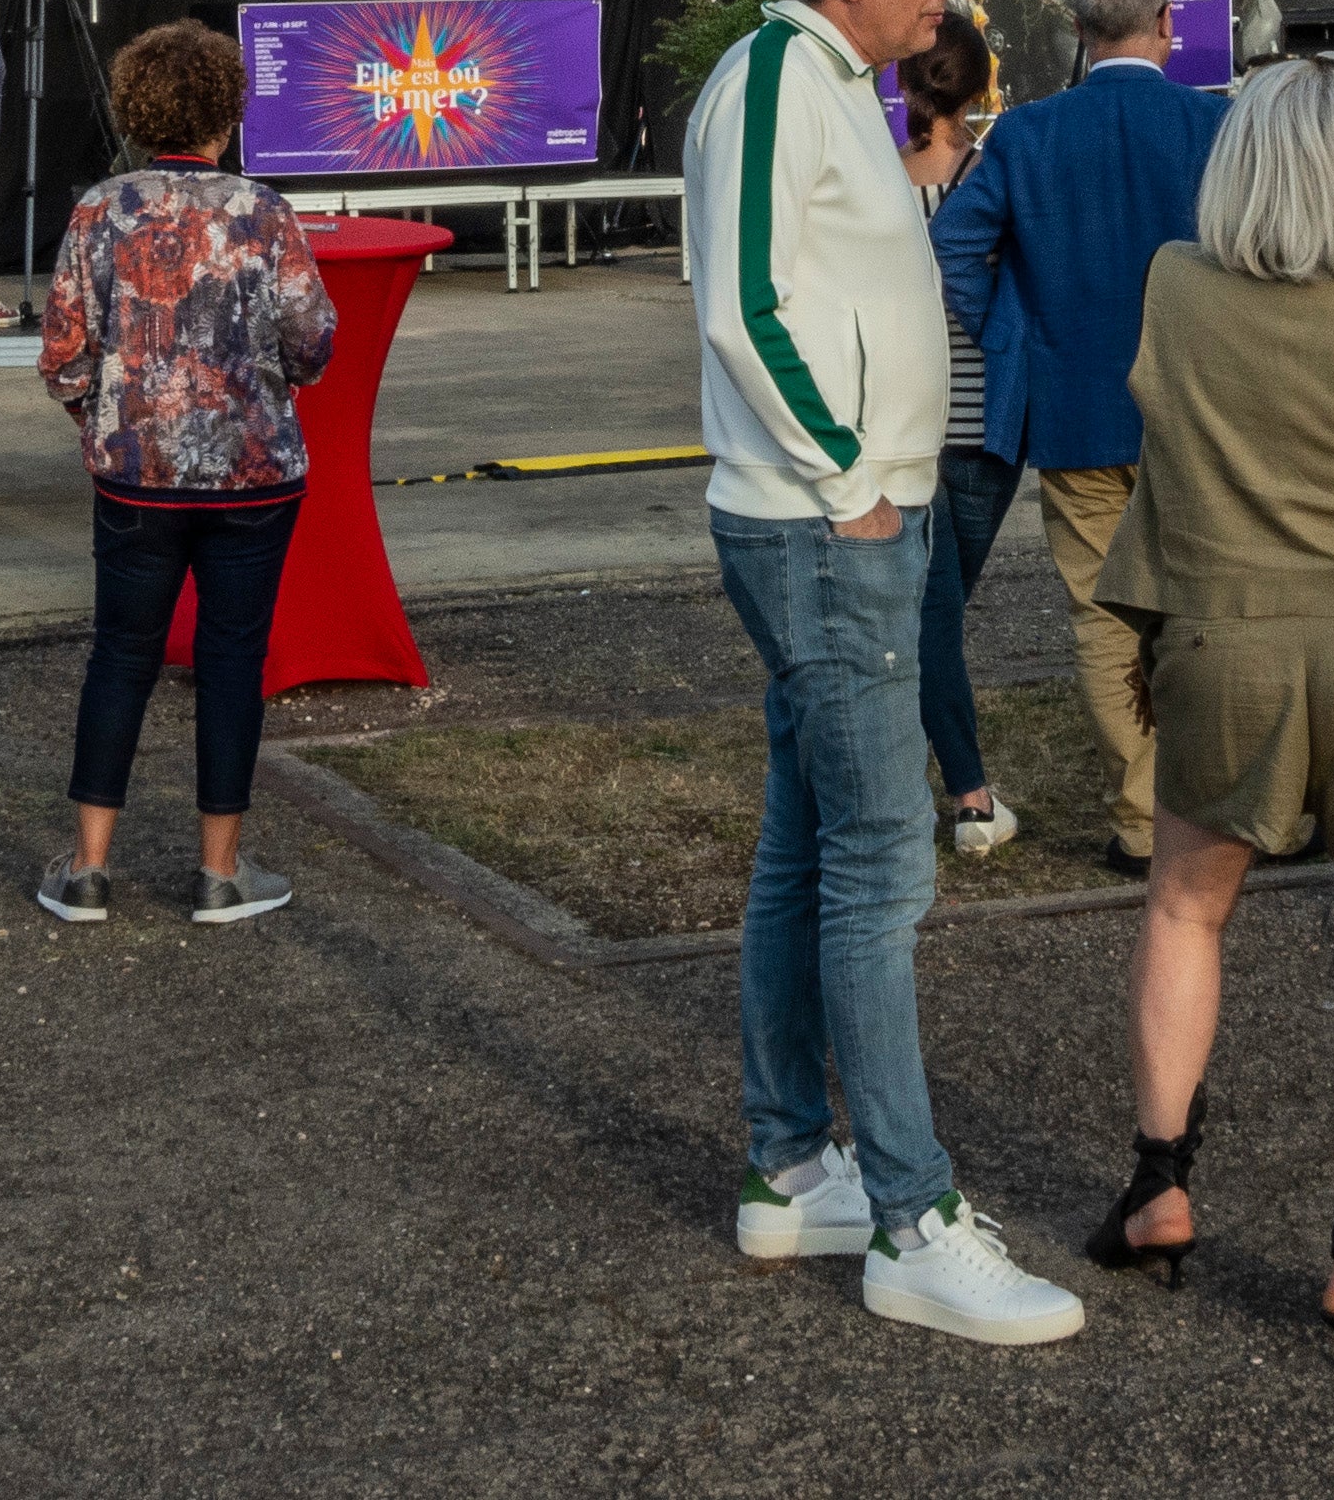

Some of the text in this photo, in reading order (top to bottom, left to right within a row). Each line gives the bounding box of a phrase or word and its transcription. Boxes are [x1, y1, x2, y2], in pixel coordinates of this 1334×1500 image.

[356, 60, 480, 94] Elle est où
[402, 89, 463, 117] mer
[471, 86, 488, 115] ?
